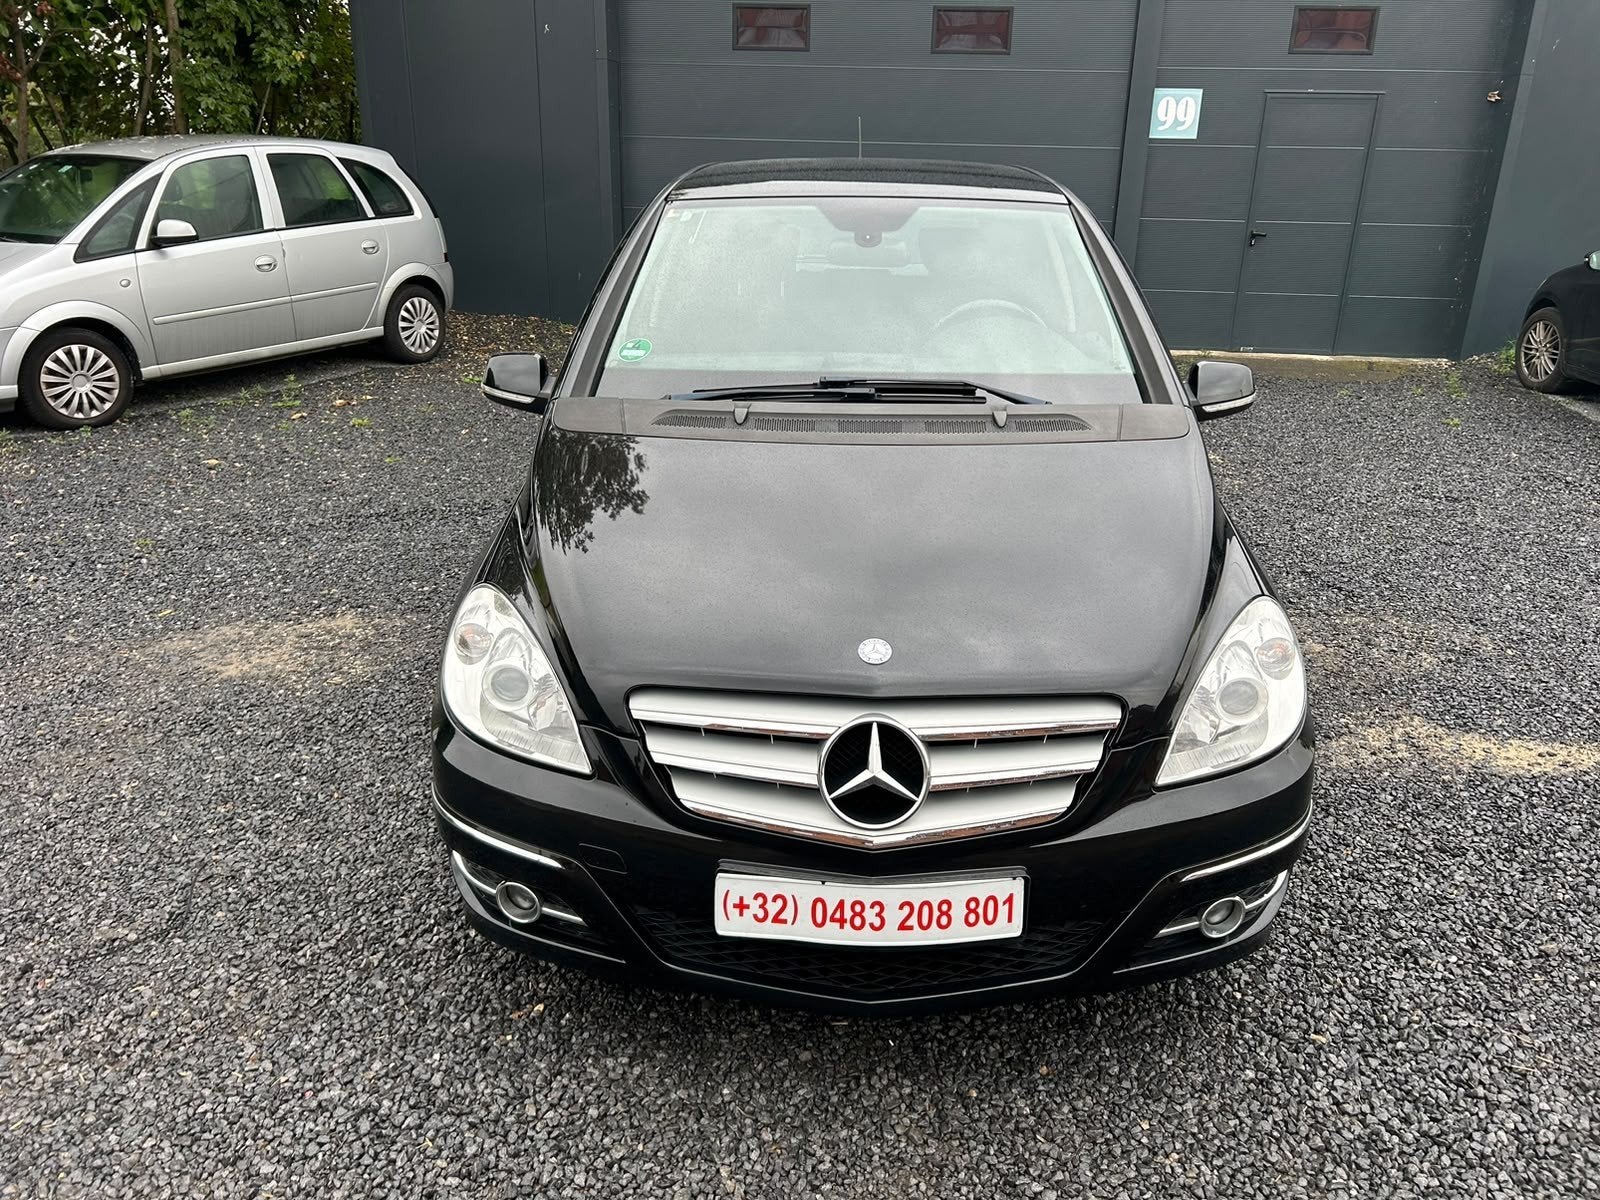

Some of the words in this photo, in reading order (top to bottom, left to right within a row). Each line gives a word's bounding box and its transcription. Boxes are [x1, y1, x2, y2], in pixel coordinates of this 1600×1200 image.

[1157, 96, 1196, 131] 99
[722, 889, 799, 926] (+32)
[810, 896, 886, 932] 0483
[897, 898, 952, 931] 208
[963, 892, 1015, 928] 801
